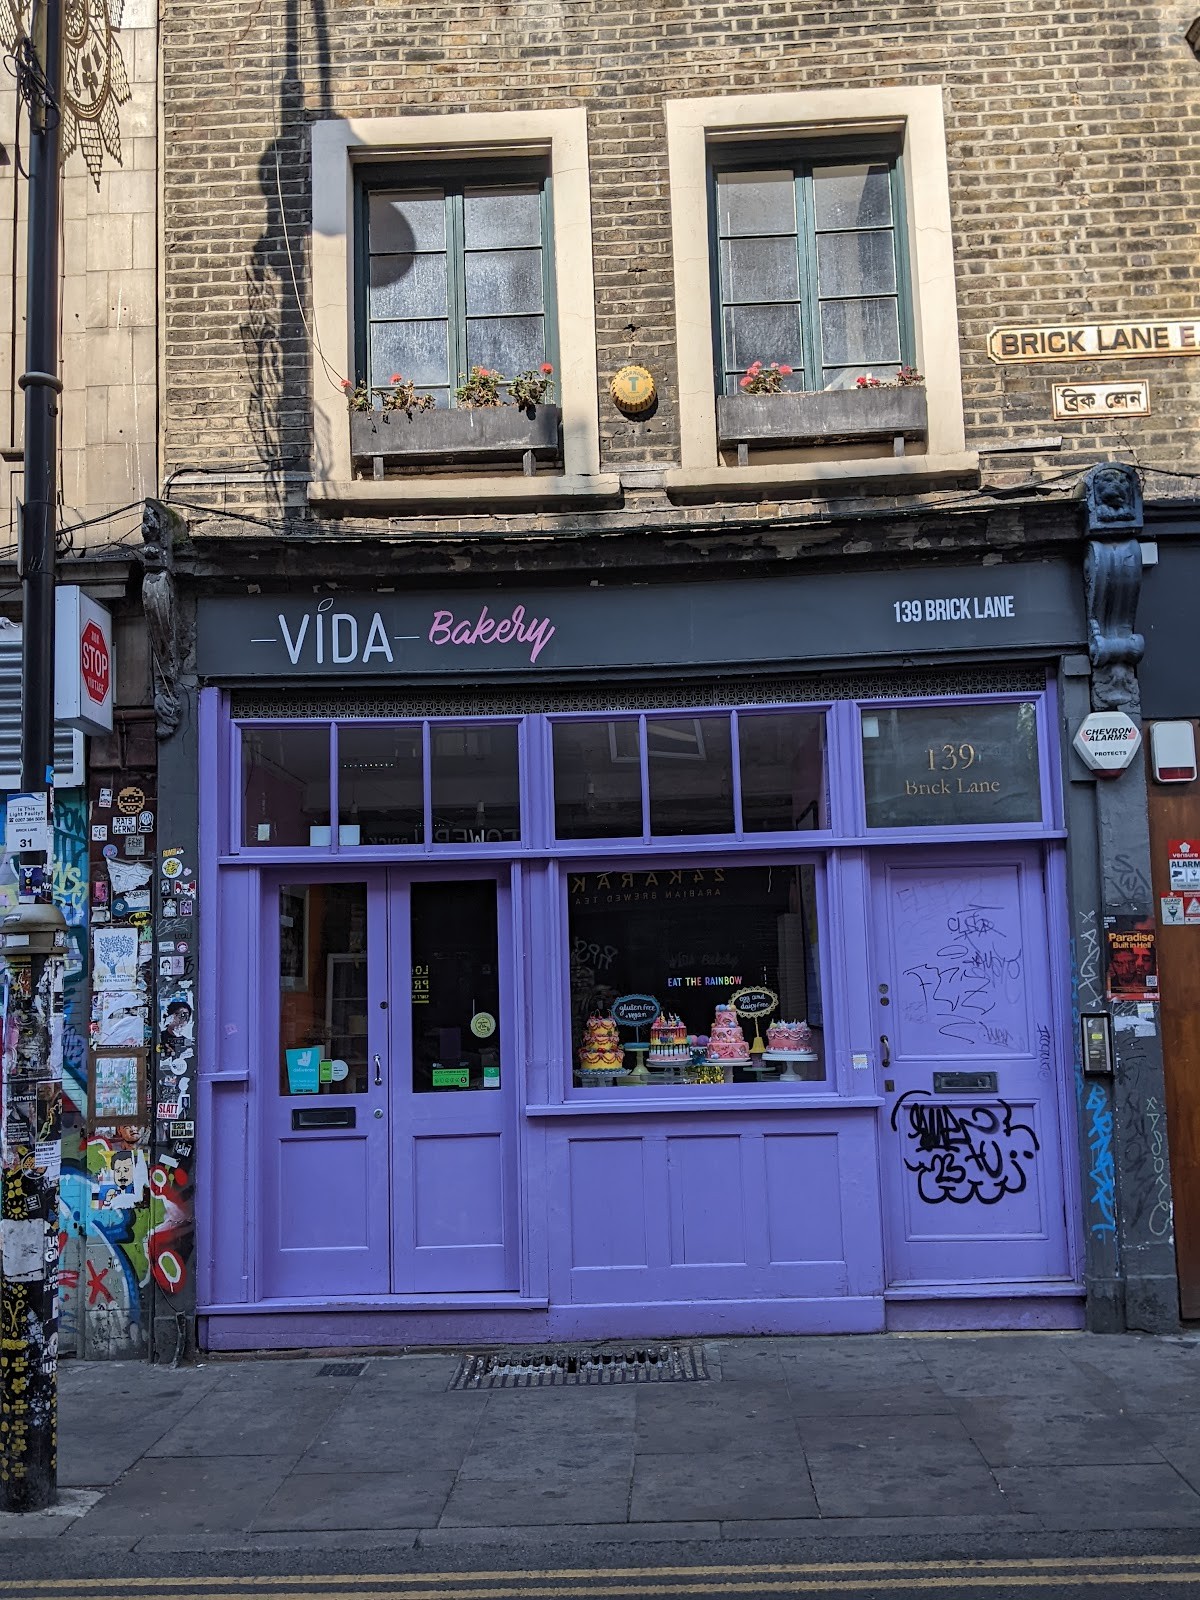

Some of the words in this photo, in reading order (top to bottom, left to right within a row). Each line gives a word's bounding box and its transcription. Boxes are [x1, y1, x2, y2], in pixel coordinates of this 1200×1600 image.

[1001, 330, 1086, 355] BRICK
[1097, 326, 1170, 352] LANE
[1061, 388, 1096, 412] ব্রিক
[1105, 390, 1141, 409] লেন
[893, 601, 922, 623] 139
[925, 598, 971, 621] BRICK
[974, 595, 1015, 619] LANE
[428, 605, 556, 663] Bakery
[82, 641, 108, 680] STOP
[1085, 727, 1132, 736] CHEVRON
[1088, 733, 1128, 742] ALARMS
[925, 743, 975, 771] 139
[906, 779, 951, 796] Brick
[957, 778, 1001, 794] Lane
[19, 838, 32, 848] 31
[1171, 860, 1200, 868] ALARM
[1108, 932, 1155, 942] Paradise
[1112, 941, 1130, 949] Built
[1137, 941, 1152, 949] Hell
[667, 977, 682, 987] EAT
[685, 976, 702, 987] THE
[704, 975, 742, 986] RAINBOW
[158, 1103, 179, 1114] SLATT
